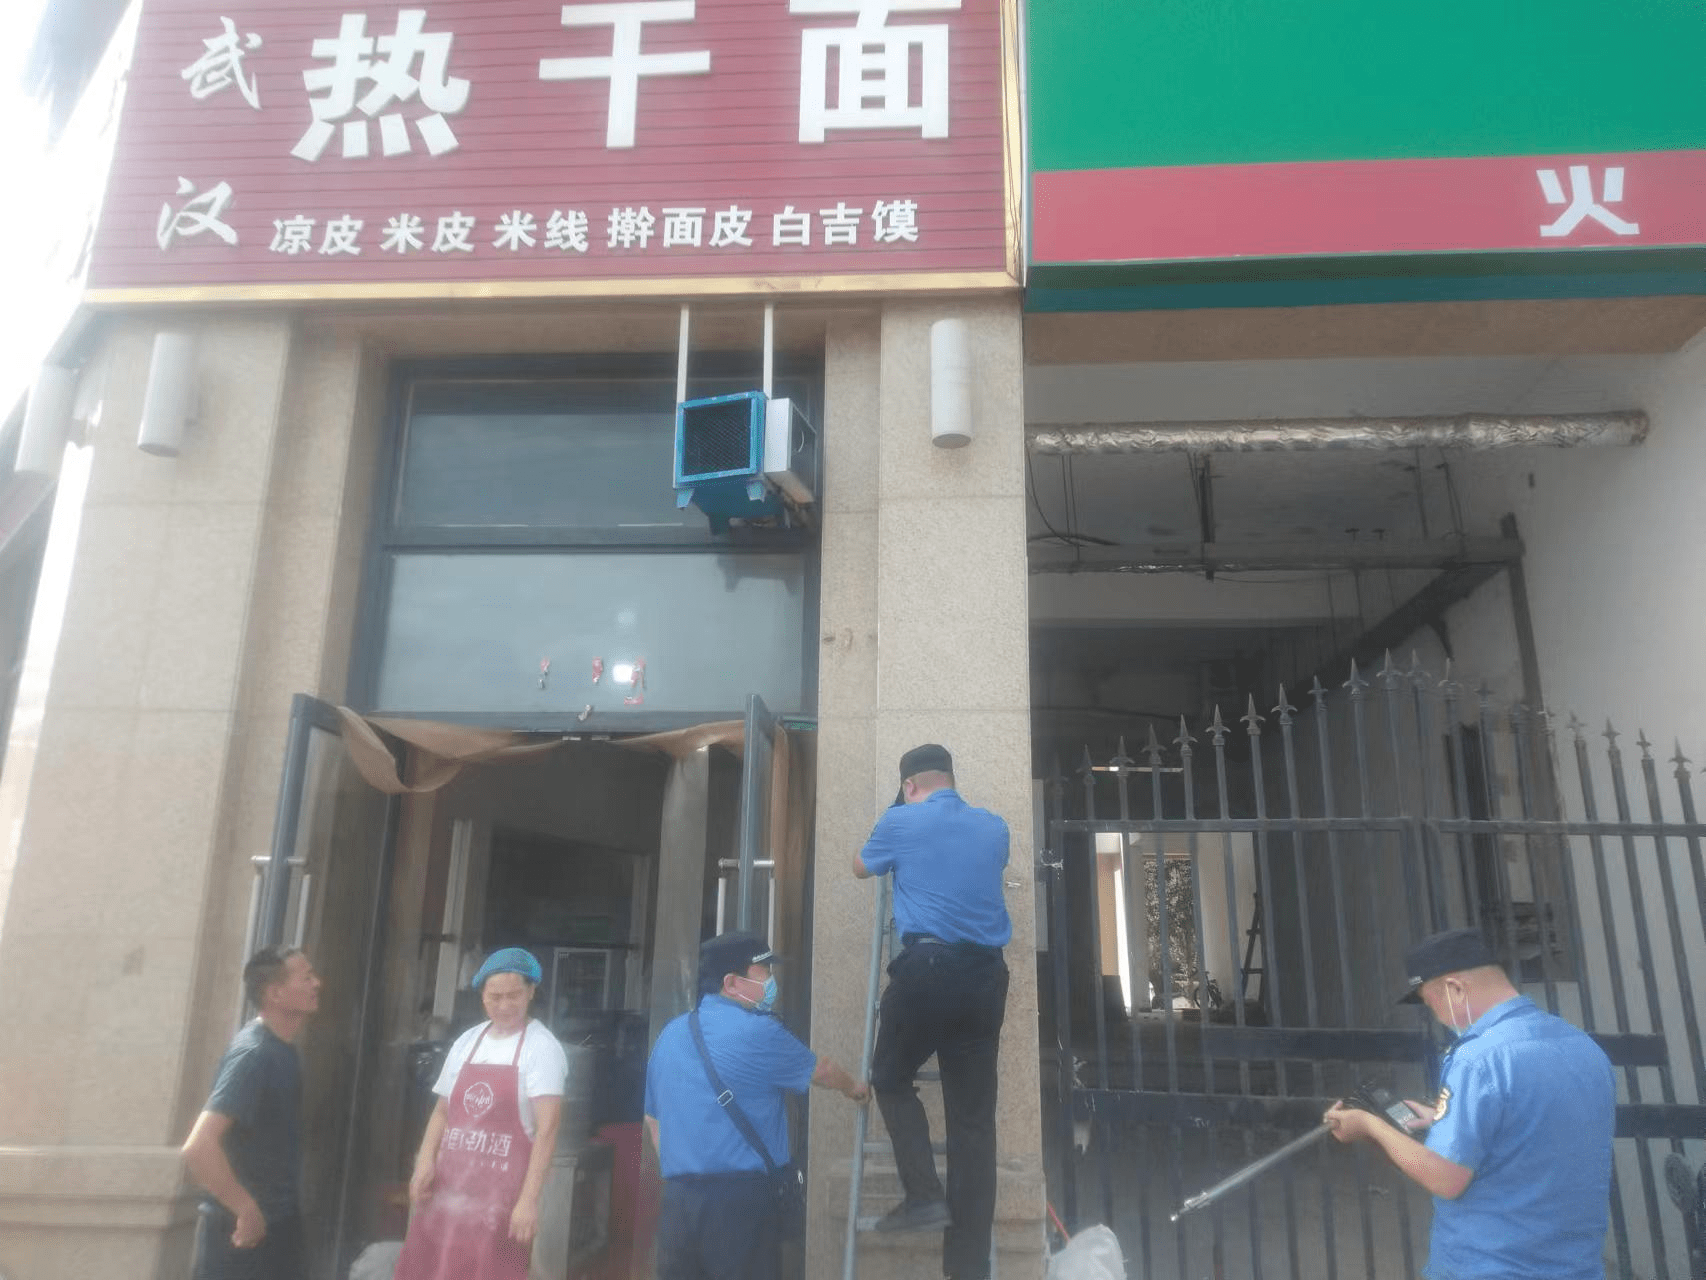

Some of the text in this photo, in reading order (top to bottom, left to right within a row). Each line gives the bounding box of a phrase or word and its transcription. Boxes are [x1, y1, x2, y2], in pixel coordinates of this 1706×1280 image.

[290, 0, 963, 162] 热干面
[269, 199, 918, 255] 凉皮 米皮 米线 擀面皮 白吉馍
[1535, 165, 1640, 237] 火
